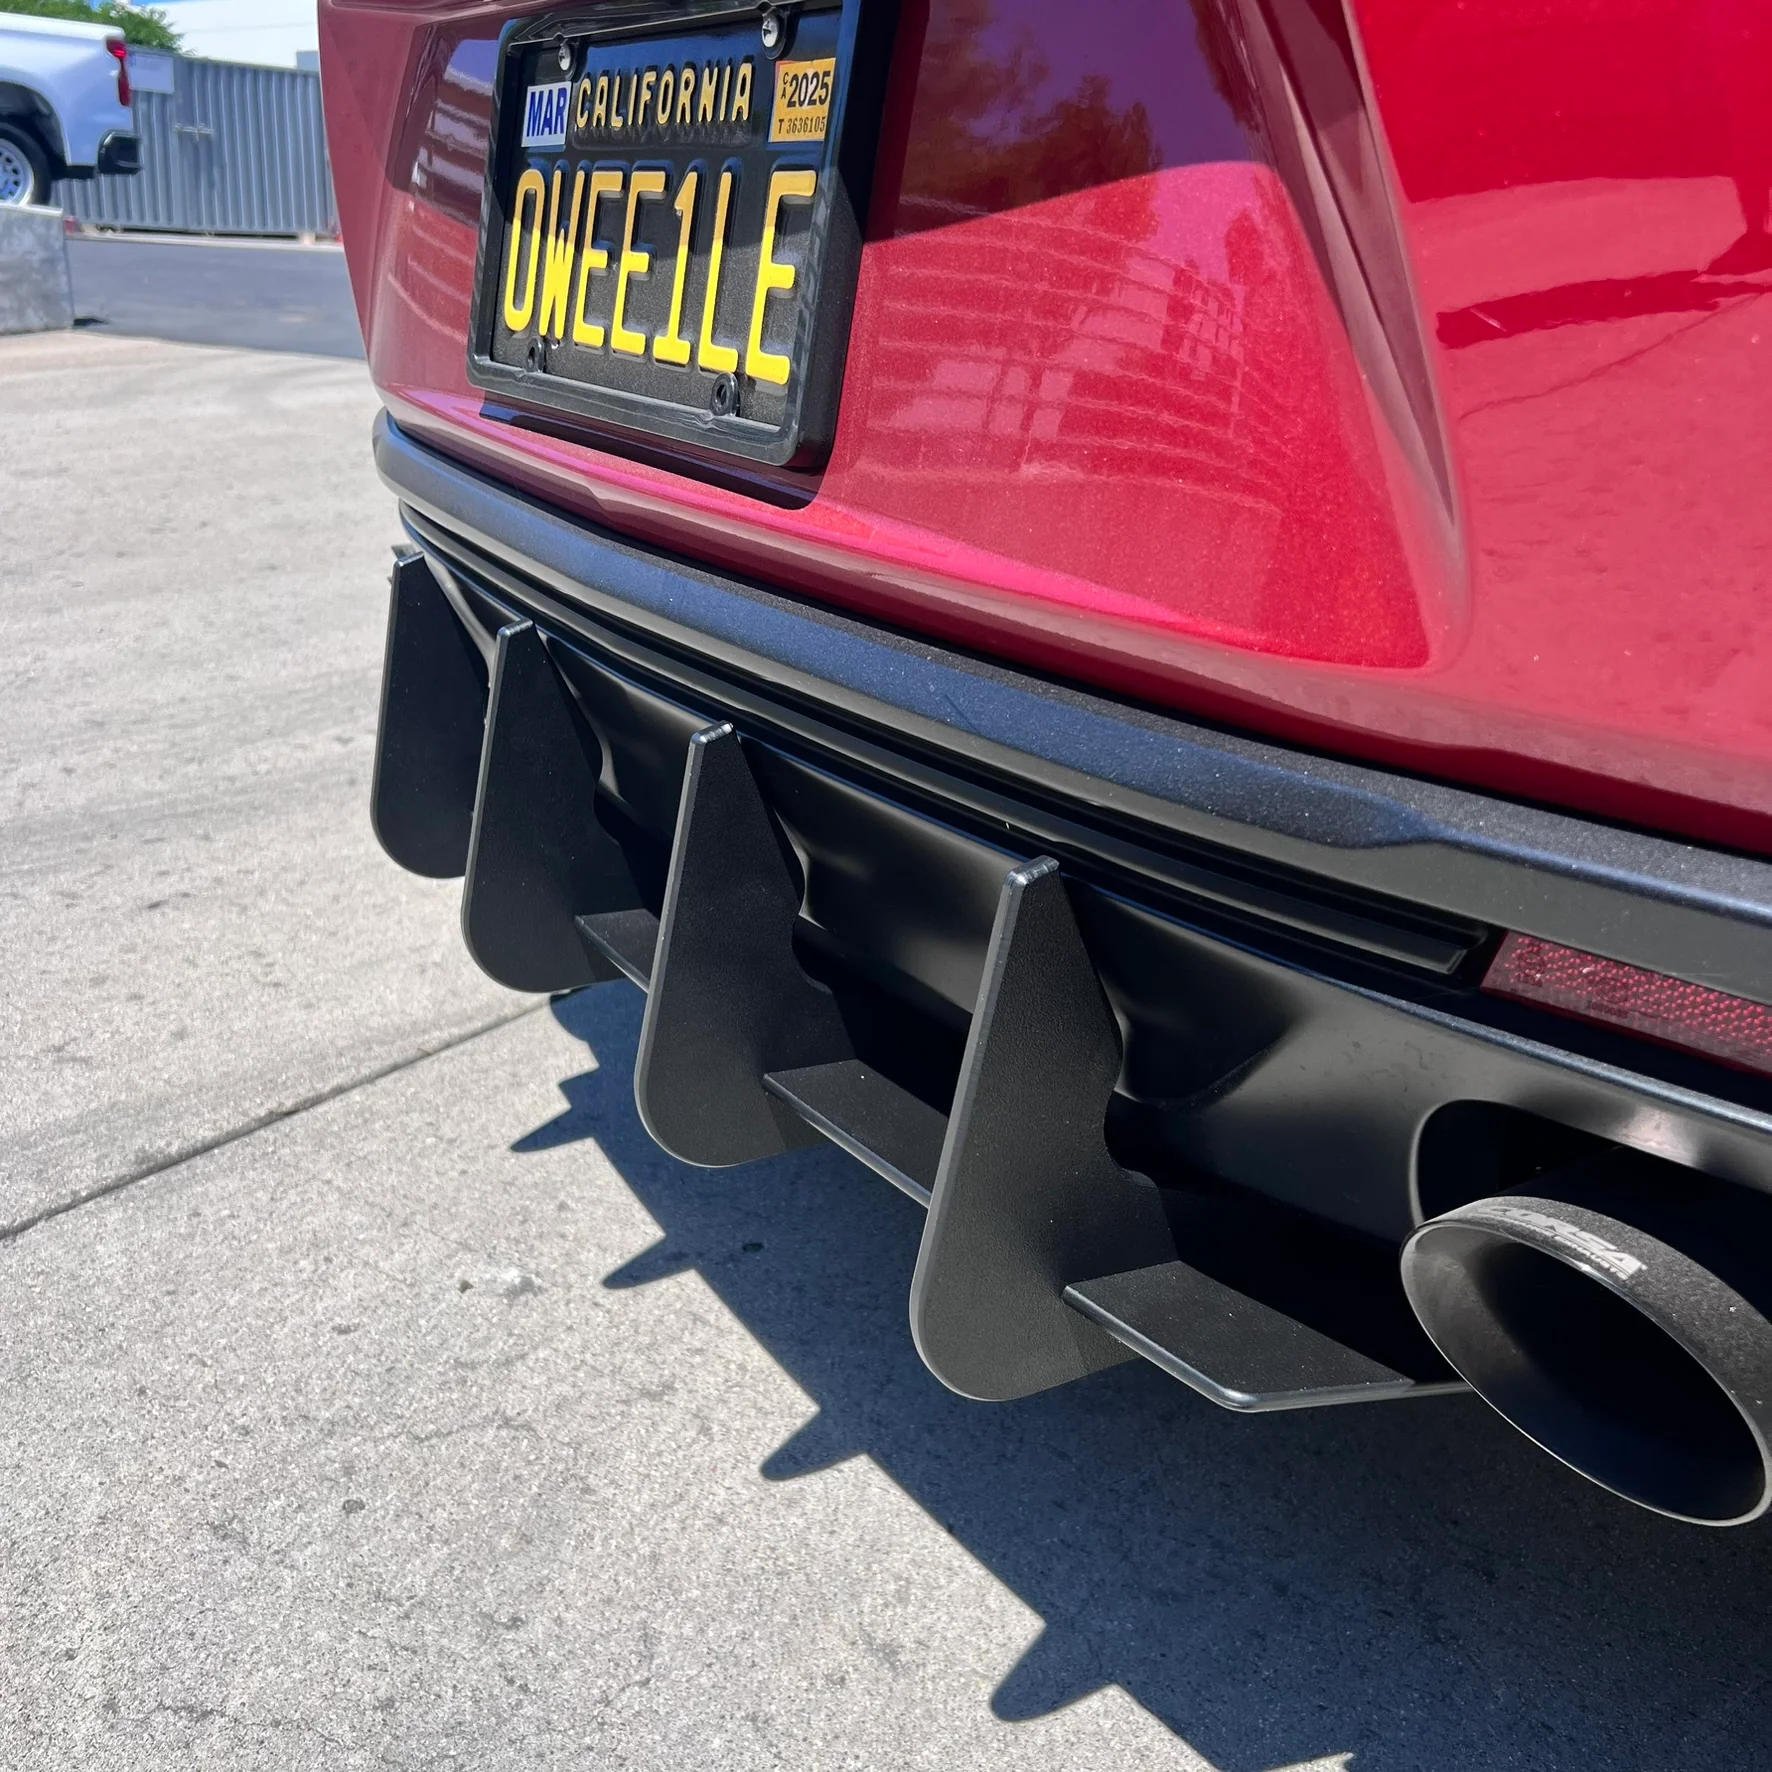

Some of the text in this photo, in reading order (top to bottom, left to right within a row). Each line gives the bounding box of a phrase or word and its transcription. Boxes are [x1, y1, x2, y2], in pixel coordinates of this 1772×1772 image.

[526, 87, 567, 137] MAR
[576, 62, 753, 129] CALIFORNIA
[787, 70, 831, 108] 2025
